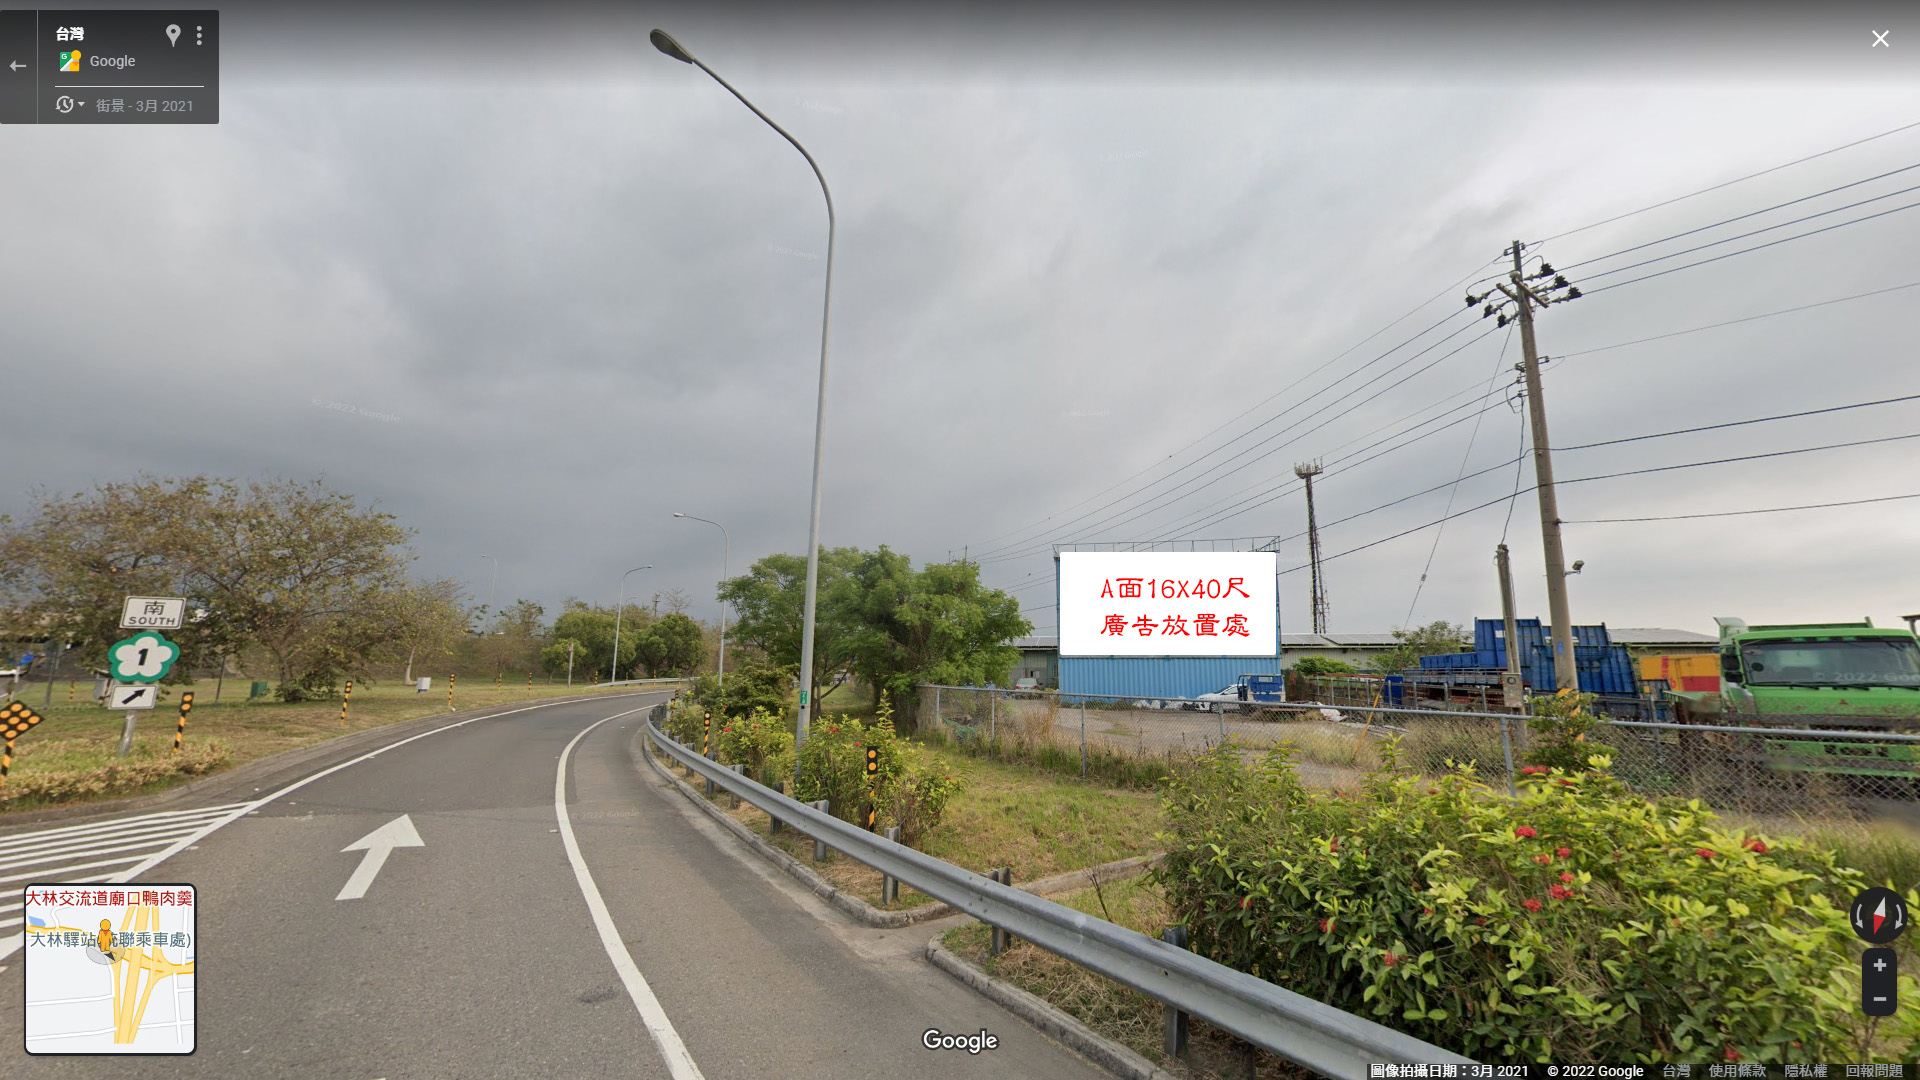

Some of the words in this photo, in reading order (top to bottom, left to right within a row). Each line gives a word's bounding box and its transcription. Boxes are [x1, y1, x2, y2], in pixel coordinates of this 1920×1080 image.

[144, 601, 166, 615] 南
[128, 616, 175, 626] SOUTH
[138, 648, 149, 666] 1
